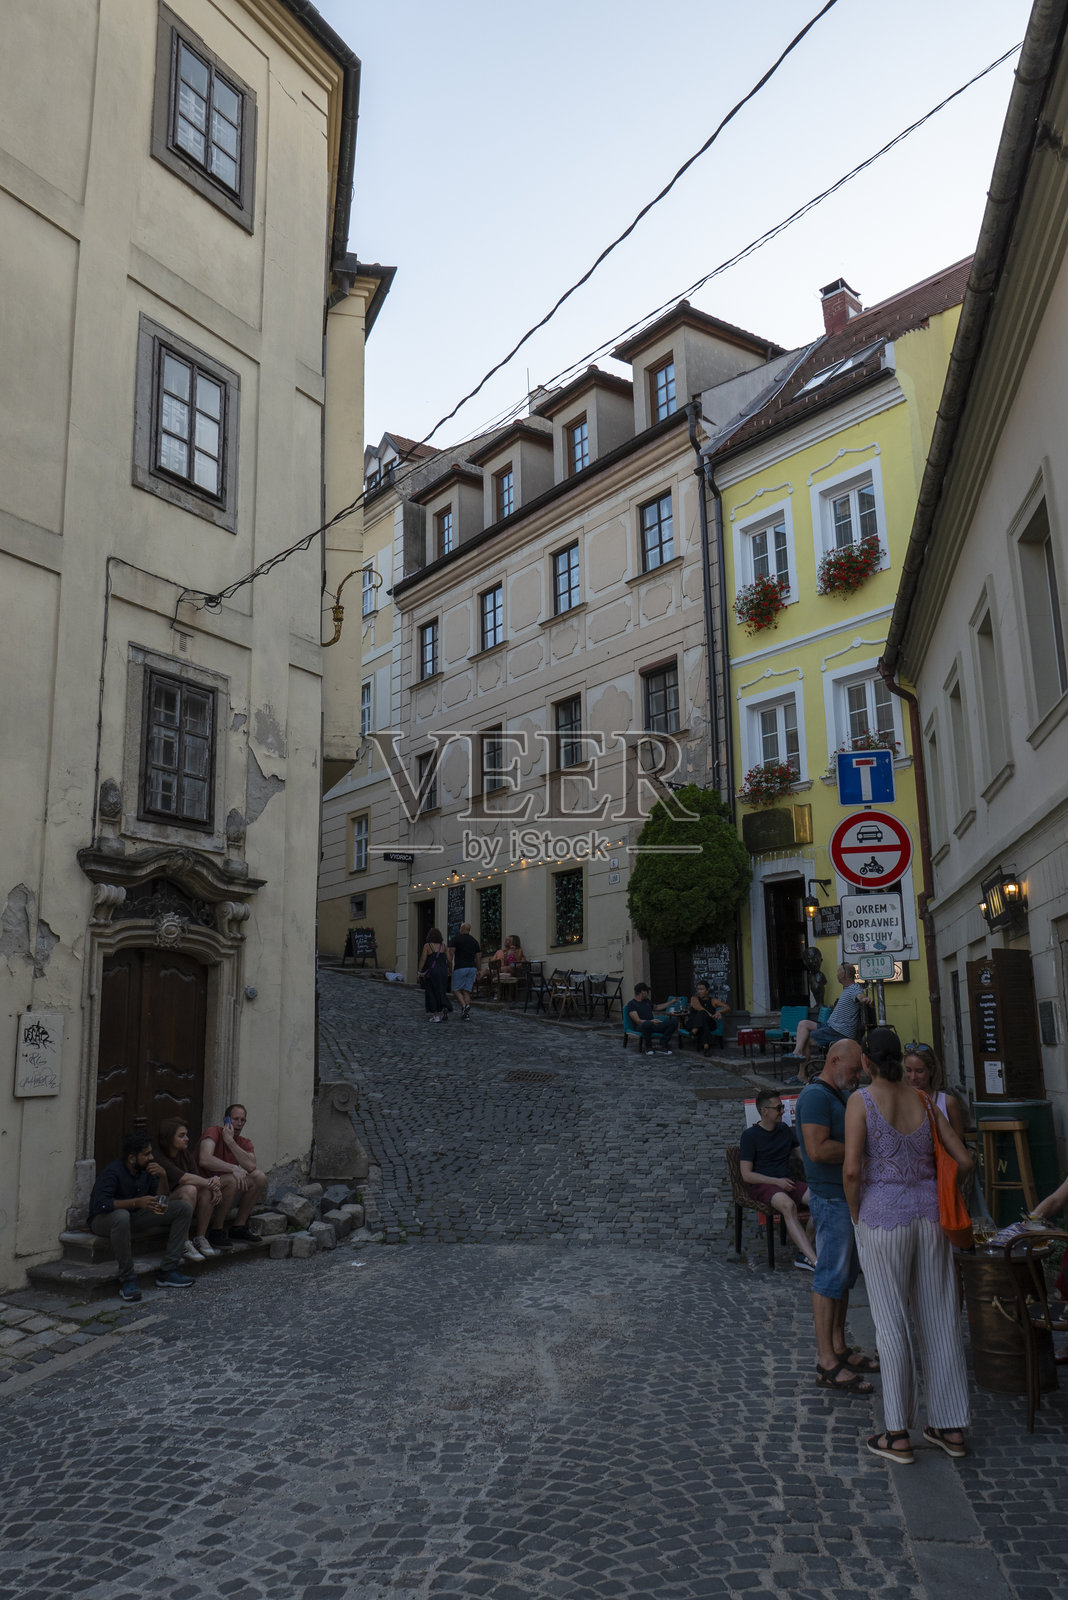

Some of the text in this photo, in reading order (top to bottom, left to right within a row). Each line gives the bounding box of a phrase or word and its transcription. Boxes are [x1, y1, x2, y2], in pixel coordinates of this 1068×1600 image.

[855, 904, 887, 914] OKREM
[846, 917, 899, 928] DOPRAVNEJ
[852, 932, 893, 943] OBSLUHY
[866, 958, 885, 967] S110
